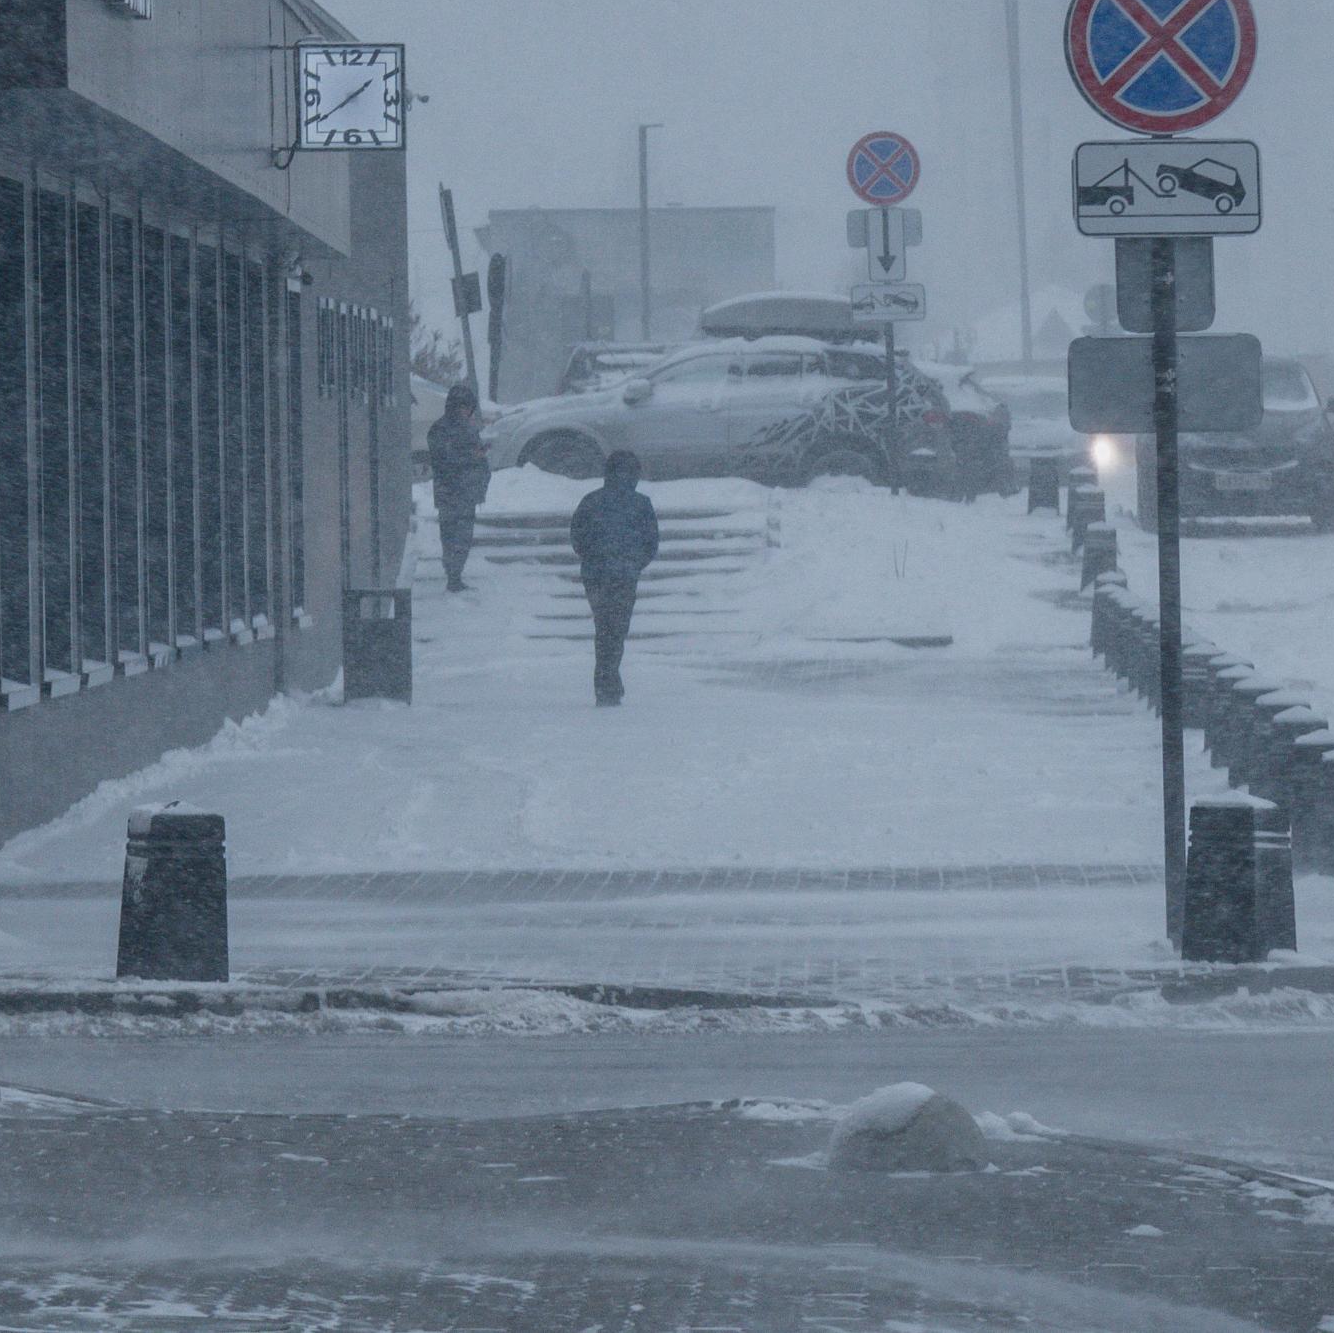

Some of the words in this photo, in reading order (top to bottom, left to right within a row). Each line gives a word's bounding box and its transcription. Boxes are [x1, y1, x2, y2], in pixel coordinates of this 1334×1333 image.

[339, 49, 364, 67] 12
[304, 88, 321, 107] 9
[383, 88, 400, 107] 3
[343, 128, 363, 146] 6
